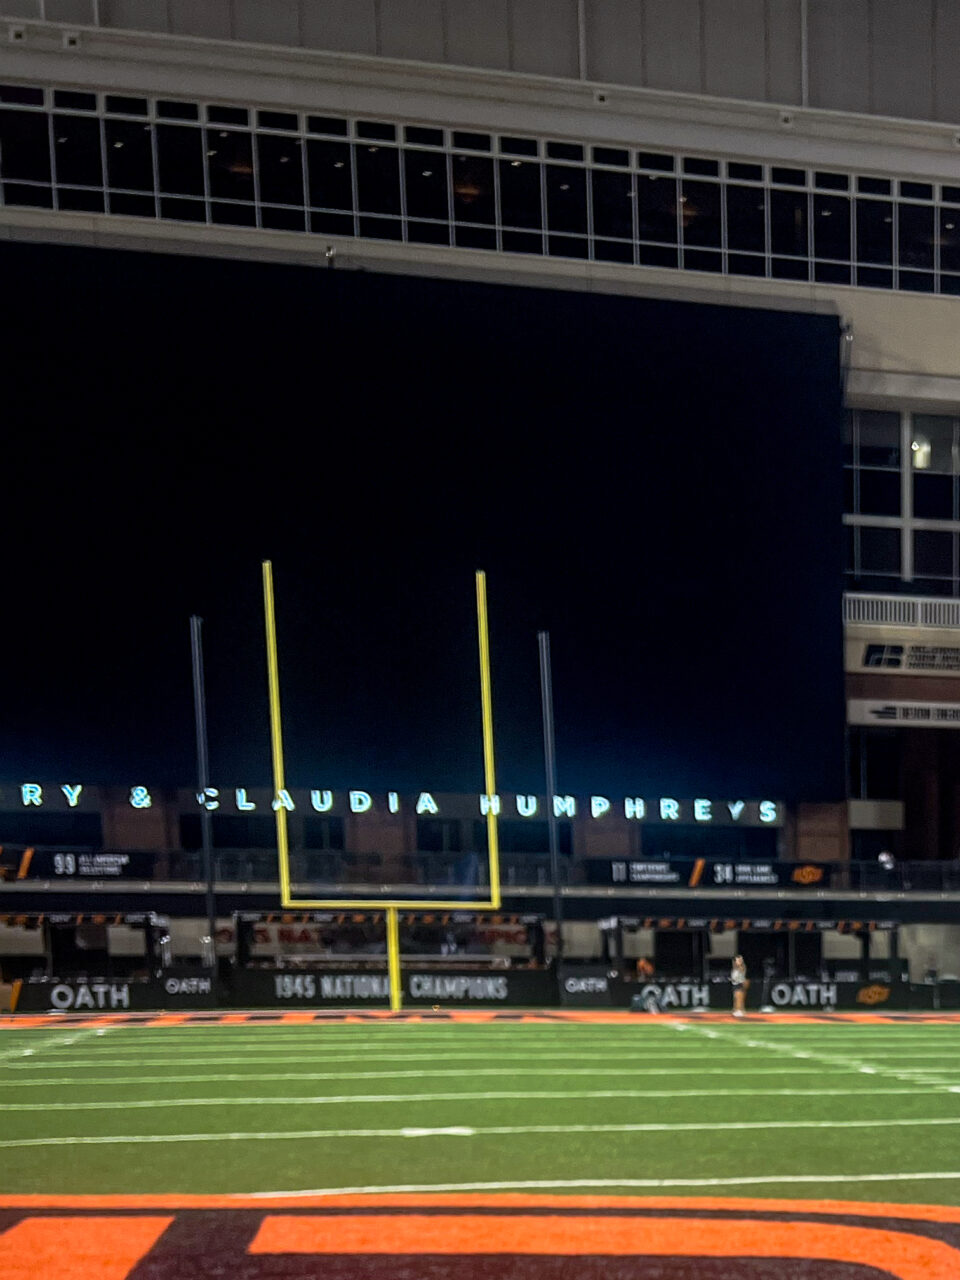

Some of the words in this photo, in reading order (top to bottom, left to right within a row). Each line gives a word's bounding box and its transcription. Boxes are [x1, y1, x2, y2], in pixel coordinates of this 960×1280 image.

[130, 786, 151, 809] &
[196, 788, 439, 814] CLAUDIA
[479, 794, 778, 823] HUMPHREYS
[51, 984, 130, 1009] OATH
[165, 977, 211, 994] OATH
[320, 975, 404, 999] NATIONA
[409, 976, 508, 999] CHAMPIONS
[565, 977, 607, 993] OATH
[771, 984, 837, 1006] OATH
